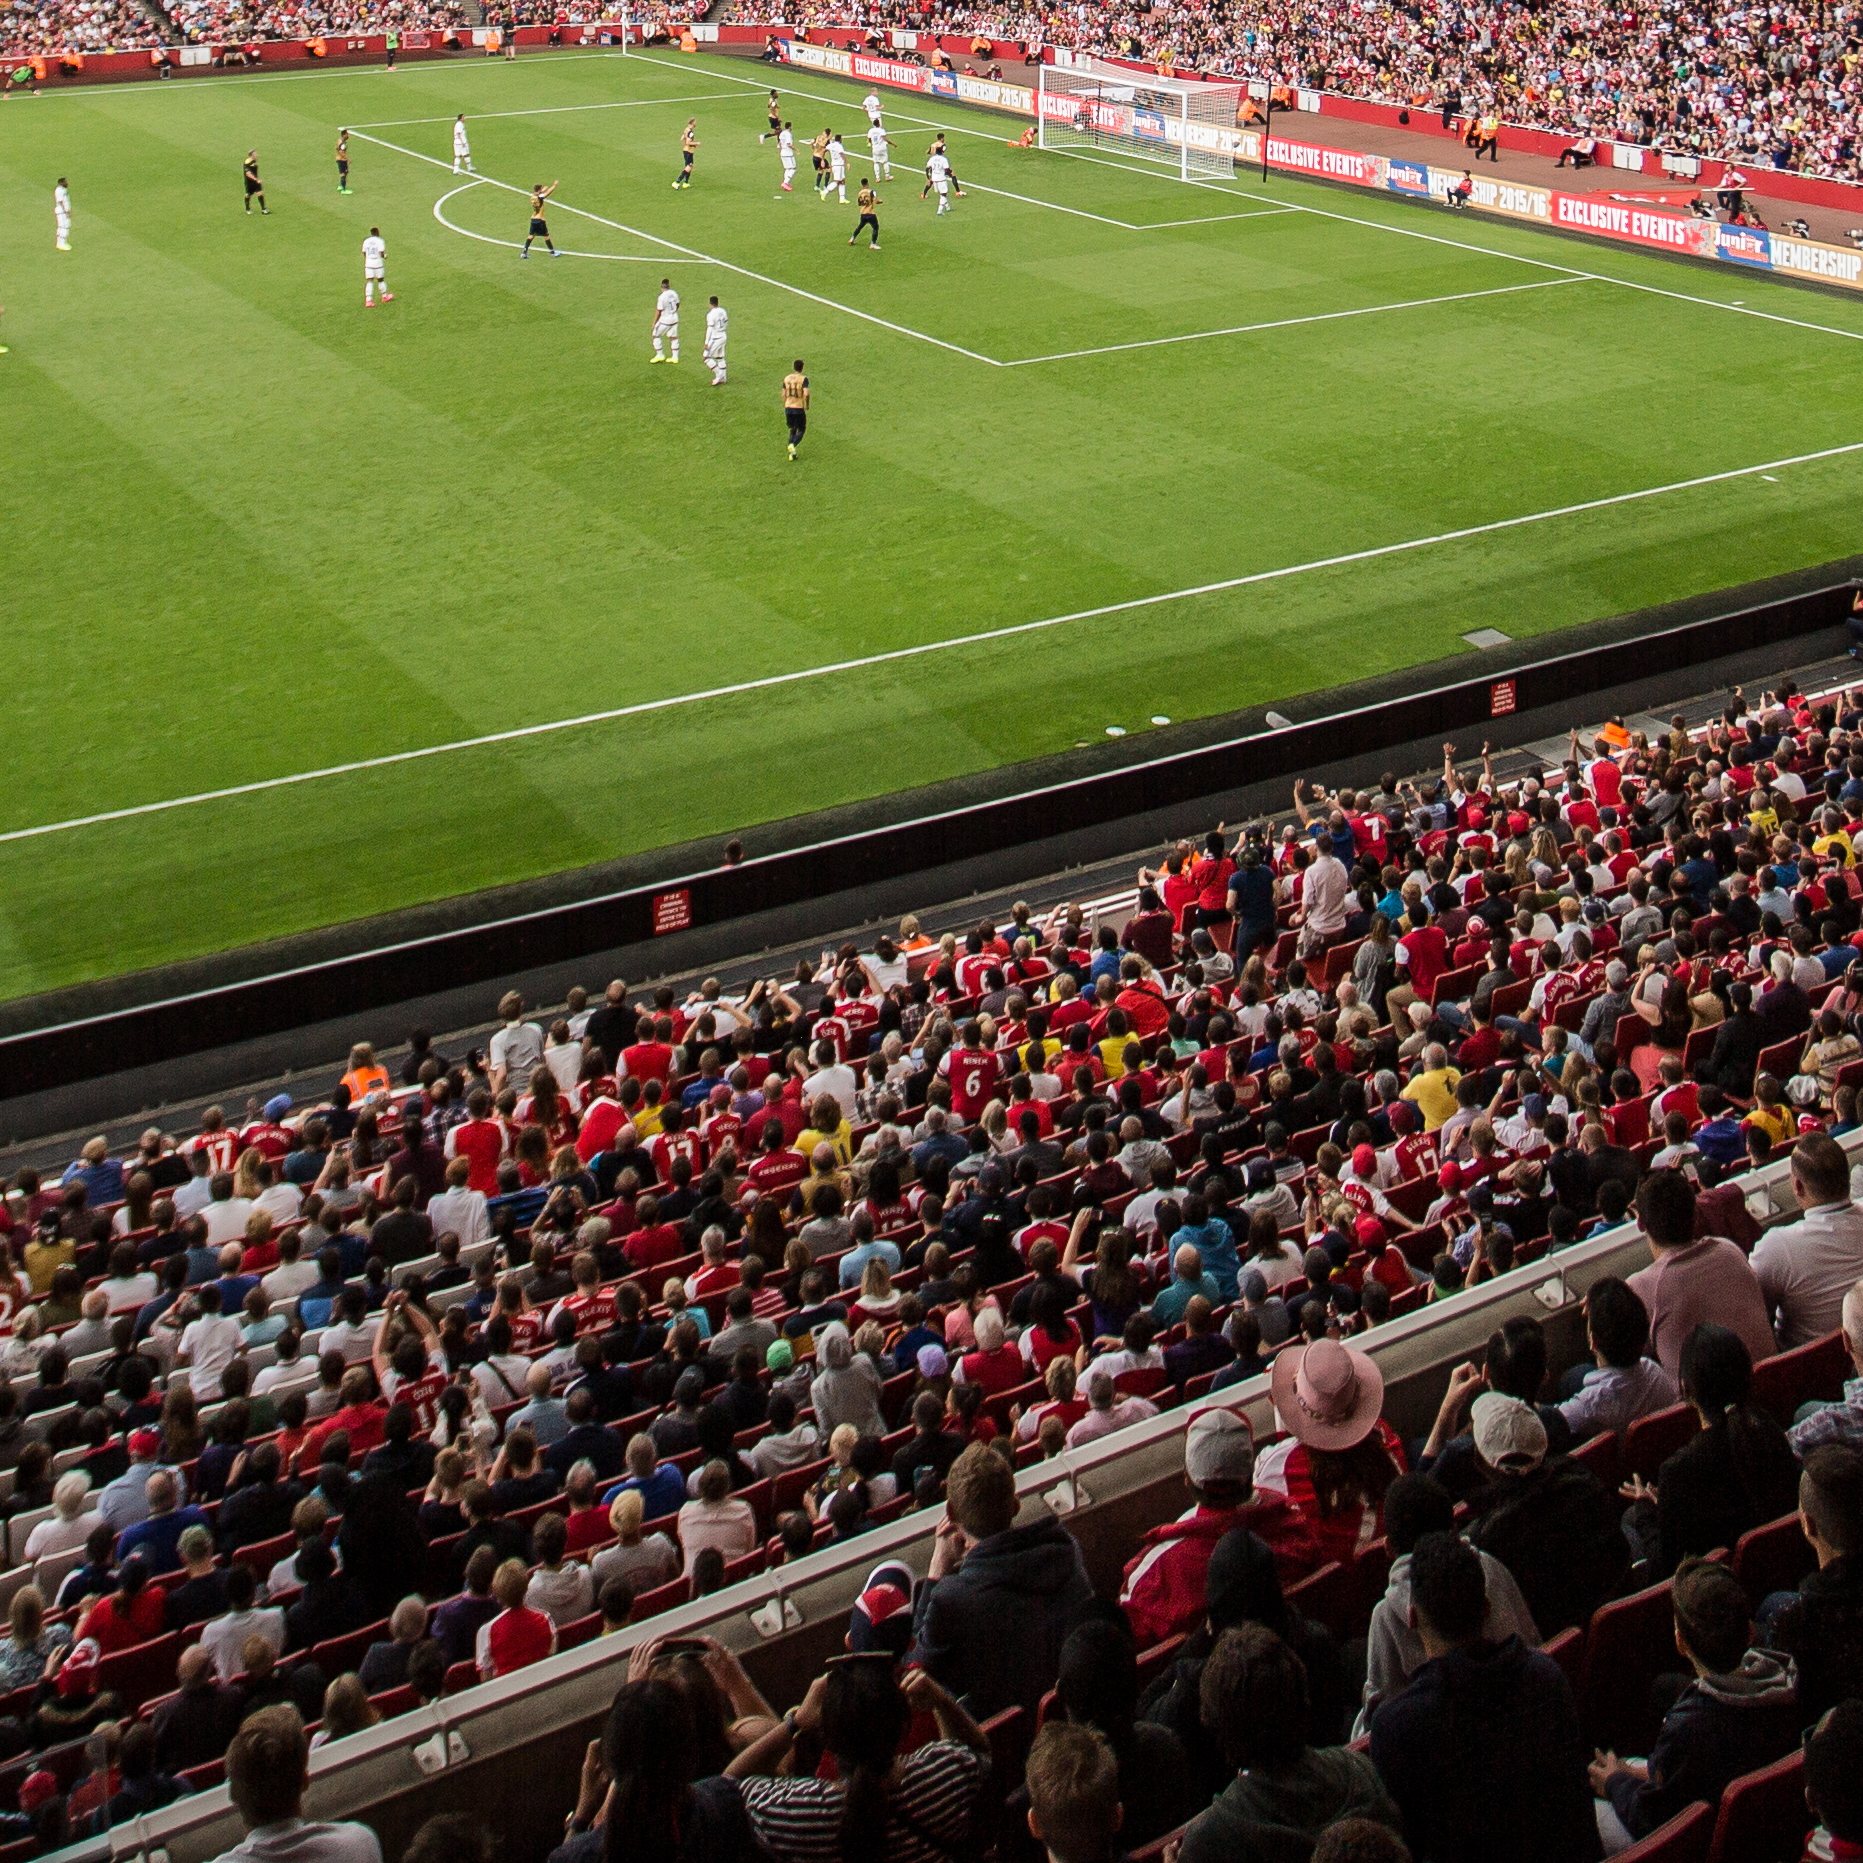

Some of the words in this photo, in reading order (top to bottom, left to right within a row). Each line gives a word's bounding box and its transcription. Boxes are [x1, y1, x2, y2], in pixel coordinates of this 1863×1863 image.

[824, 51, 850, 72] 2015/16
[854, 57, 890, 80] EXCLUSIVE
[891, 64, 917, 86] EVENTS
[958, 77, 1000, 104] MEMBERSHIP
[1001, 87, 1032, 111] 2015/16
[1266, 139, 1322, 172] EXCLUSIVE
[1324, 150, 1364, 180] EVENTS
[1499, 186, 1547, 217] 2015/16
[1559, 197, 1629, 236] EXCLUSIVE
[1633, 212, 1685, 245] EVENTS
[1714, 226, 1765, 256] Junior
[1770, 235, 1862, 282] MEMBERSHIP
[1364, 817, 1380, 842] 7
[1525, 948, 1541, 975] 7
[966, 1069, 981, 1098] 6
[208, 1141, 233, 1176] 17
[1416, 1148, 1439, 1179] 17
